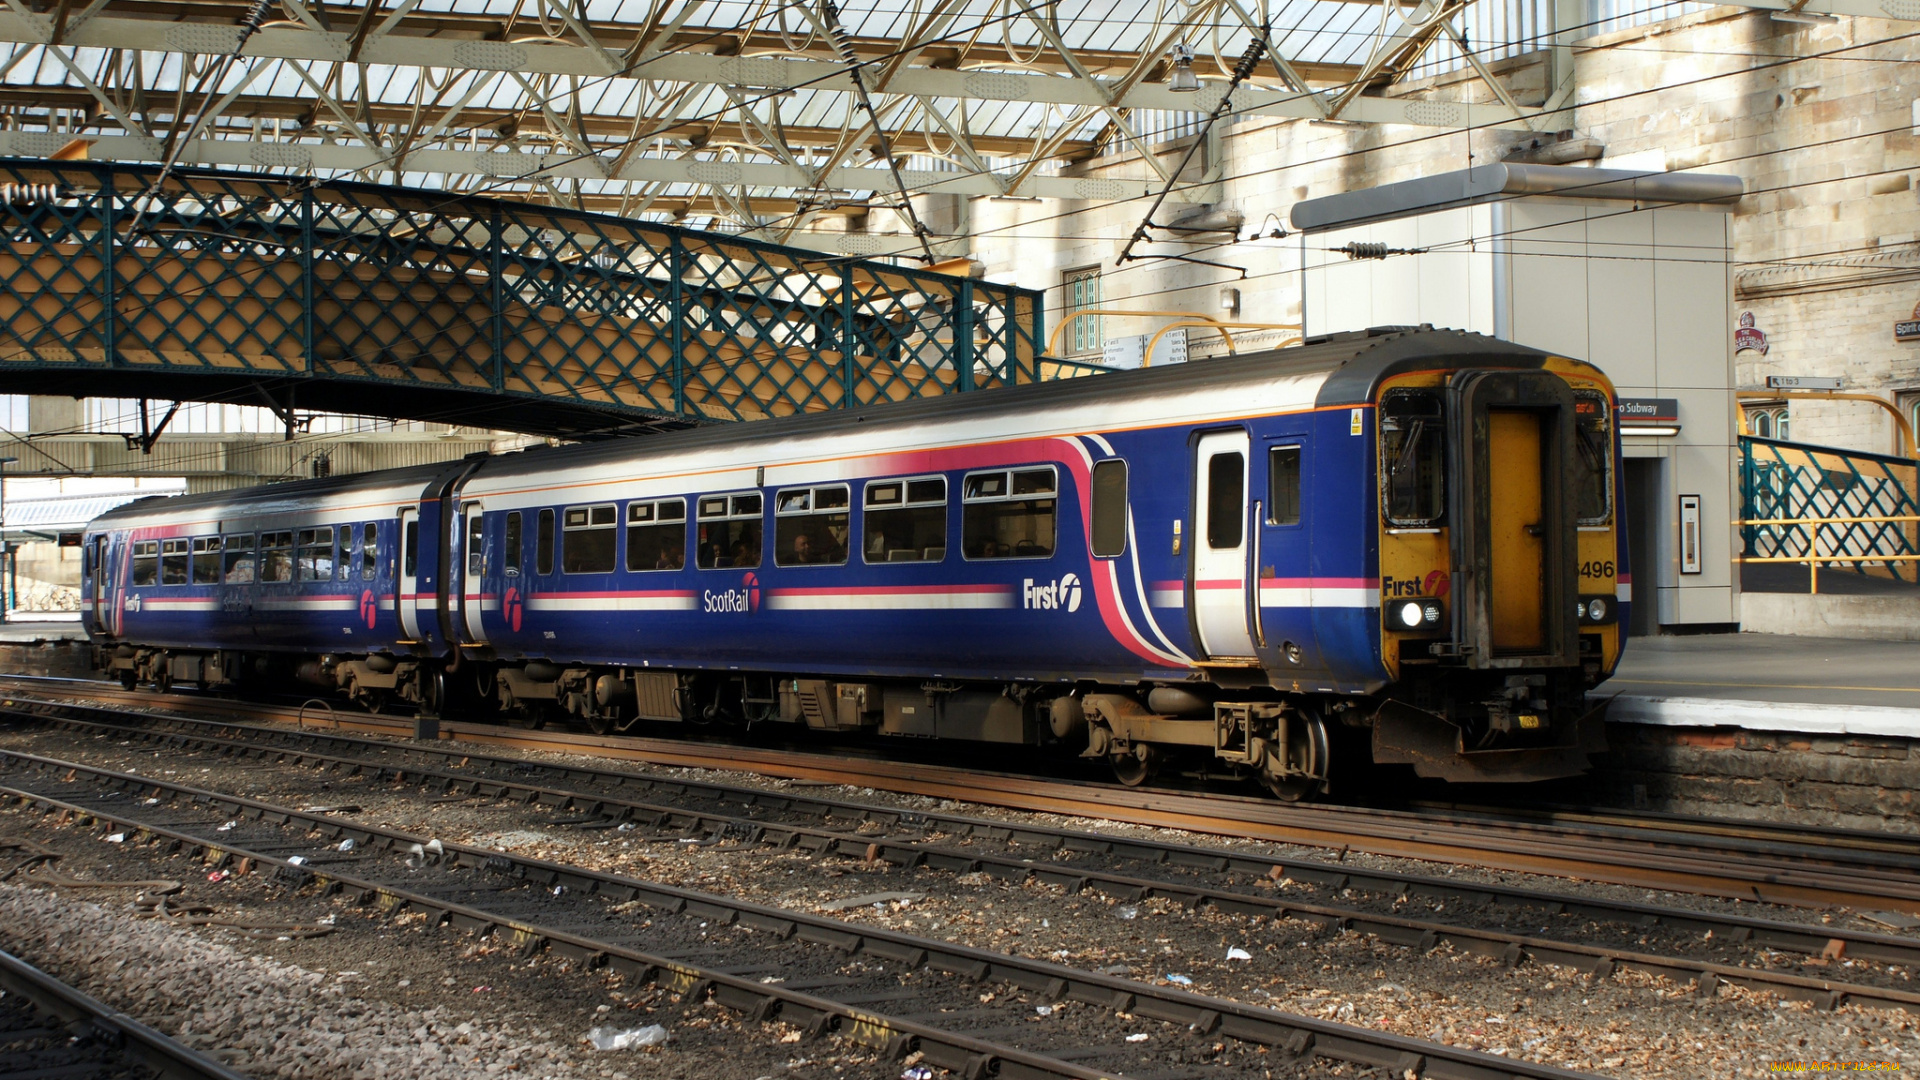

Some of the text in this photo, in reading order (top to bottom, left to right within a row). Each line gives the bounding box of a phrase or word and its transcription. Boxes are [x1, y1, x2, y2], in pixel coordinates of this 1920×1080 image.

[1896, 322, 1917, 335] Spirit
[1626, 402, 1657, 415] Subway
[1577, 561, 1615, 579] 496
[1024, 579, 1058, 609] First
[1382, 576, 1422, 597] First
[704, 588, 749, 613] ScotRail
